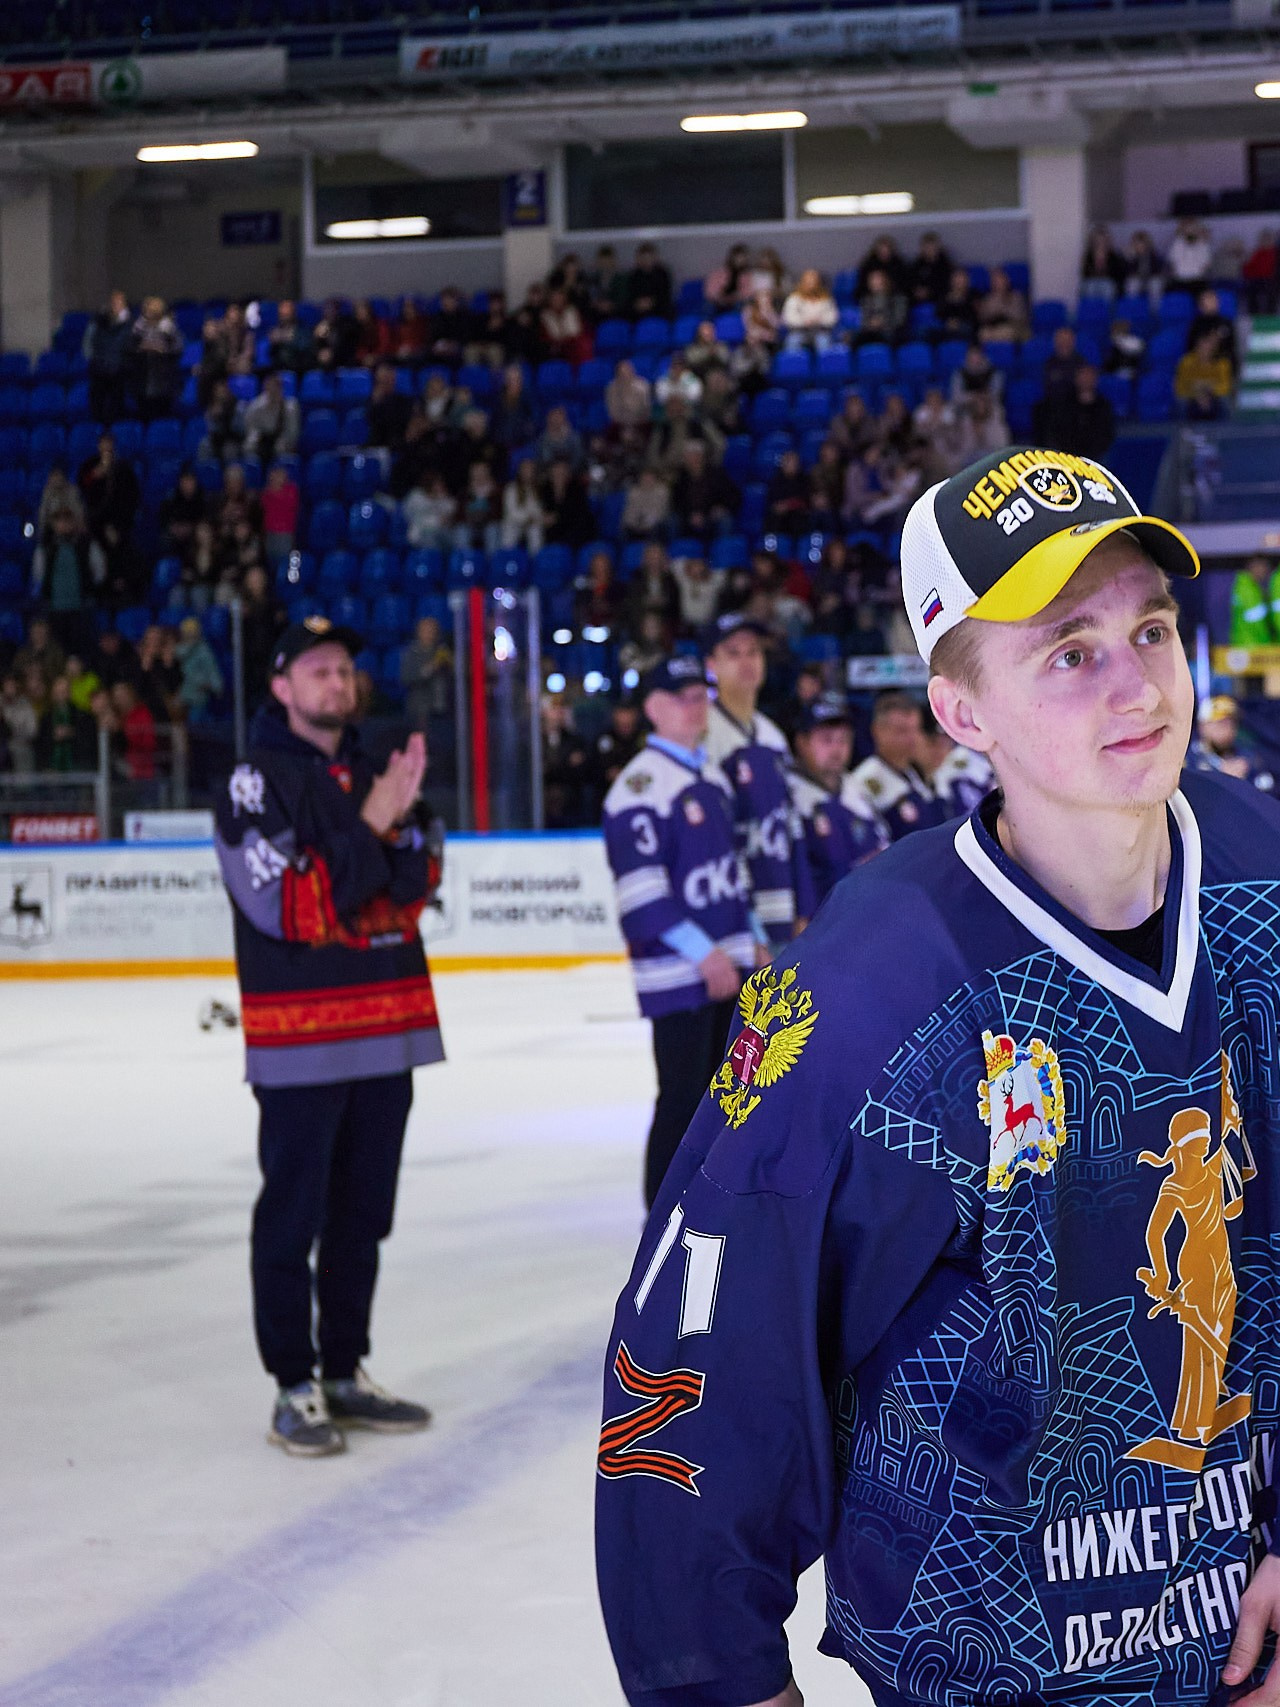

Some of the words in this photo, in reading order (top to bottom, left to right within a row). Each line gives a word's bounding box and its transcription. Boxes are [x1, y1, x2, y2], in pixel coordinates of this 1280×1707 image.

[996, 496, 1035, 536] 20
[13, 815, 97, 842] FONBET
[631, 812, 659, 856] 3
[66, 872, 222, 893] ПРАВИТЕЛЬСТ
[470, 872, 582, 893] НИЖНИЙ
[471, 903, 608, 924] НОВГОРОД
[1063, 1560, 1249, 1674] ОБЛАСТНО
